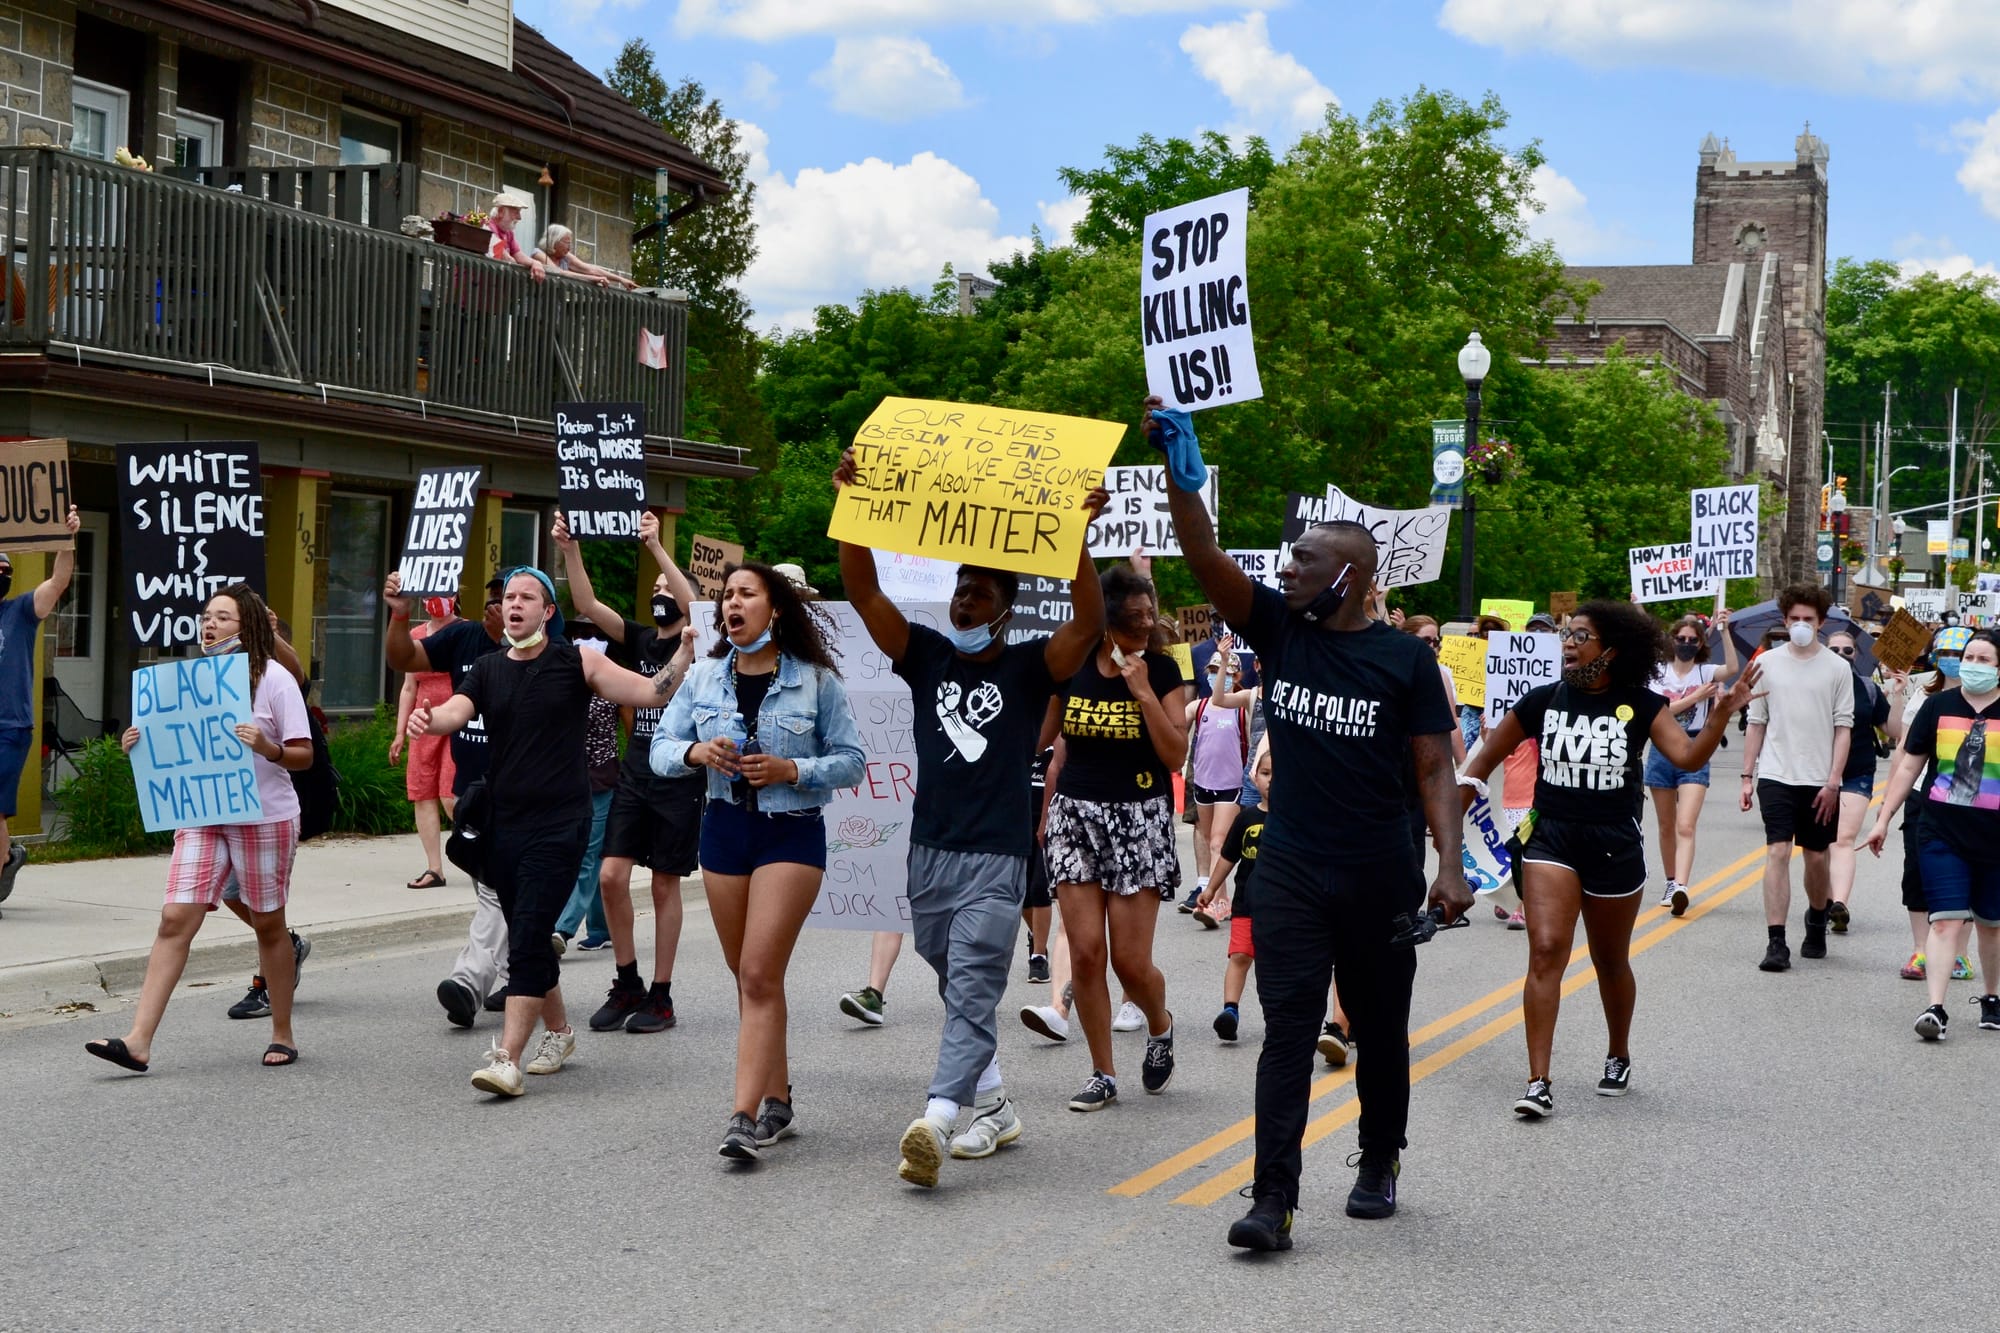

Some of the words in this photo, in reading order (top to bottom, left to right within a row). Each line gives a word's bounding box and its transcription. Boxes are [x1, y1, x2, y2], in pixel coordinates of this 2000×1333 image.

[1152, 213, 1229, 281] STOP
[1144, 275, 1247, 346] KILLING
[1169, 344, 1233, 405] US!!
[557, 412, 594, 435] Racism
[597, 413, 635, 435] Isn't
[894, 409, 965, 428] OUR
[977, 416, 1056, 441] LIVES
[1435, 433, 1464, 443] FERGUS
[558, 440, 598, 466] Getting
[598, 438, 643, 460] WORSE
[861, 424, 950, 446] BEGIN
[960, 436, 993, 453] TO
[1007, 442, 1061, 460] END
[854, 443, 909, 466] THE
[917, 449, 952, 470] DAY
[966, 457, 1002, 477] WE
[1014, 461, 1103, 491] BECOME
[414, 470, 481, 509] BLACK
[560, 466, 589, 490] It's
[595, 468, 645, 501] Getting
[853, 466, 922, 492] SILENT
[929, 473, 985, 494] ABOUT
[999, 481, 1074, 509] THINGS
[1125, 497, 1142, 515] IS
[1695, 490, 1754, 518] BLACK
[408, 513, 466, 550] LIVES
[849, 496, 911, 523] THAT
[918, 501, 1061, 554] MATTER
[1698, 521, 1755, 547] LIVES
[694, 542, 723, 566] STOP
[1232, 554, 1265, 571] THIS
[1632, 547, 1664, 564] HOW
[1694, 549, 1754, 578] MATTER
[399, 556, 463, 592] MATTER
[1036, 577, 1054, 592] Do
[1958, 594, 1987, 607] POWER
[1510, 635, 1536, 654] NO
[1487, 655, 1553, 677] JUSTICE
[136, 656, 240, 717] BLACK
[1507, 679, 1531, 697] NO
[1067, 696, 1141, 713] BLACK
[1271, 679, 1311, 713] DEAR
[1314, 693, 1380, 726] POLICE
[1063, 721, 1140, 739] MATTER
[1064, 709, 1140, 726] LIVES
[1297, 713, 1331, 732] WHITE
[1336, 723, 1375, 737] WOMAN
[1543, 708, 1628, 739] BLACK
[140, 711, 243, 769] LIVES
[1541, 734, 1628, 766] LIVES
[1542, 758, 1626, 790] MATTER
[148, 769, 260, 823] MATTER
[828, 892, 887, 917] DICK
